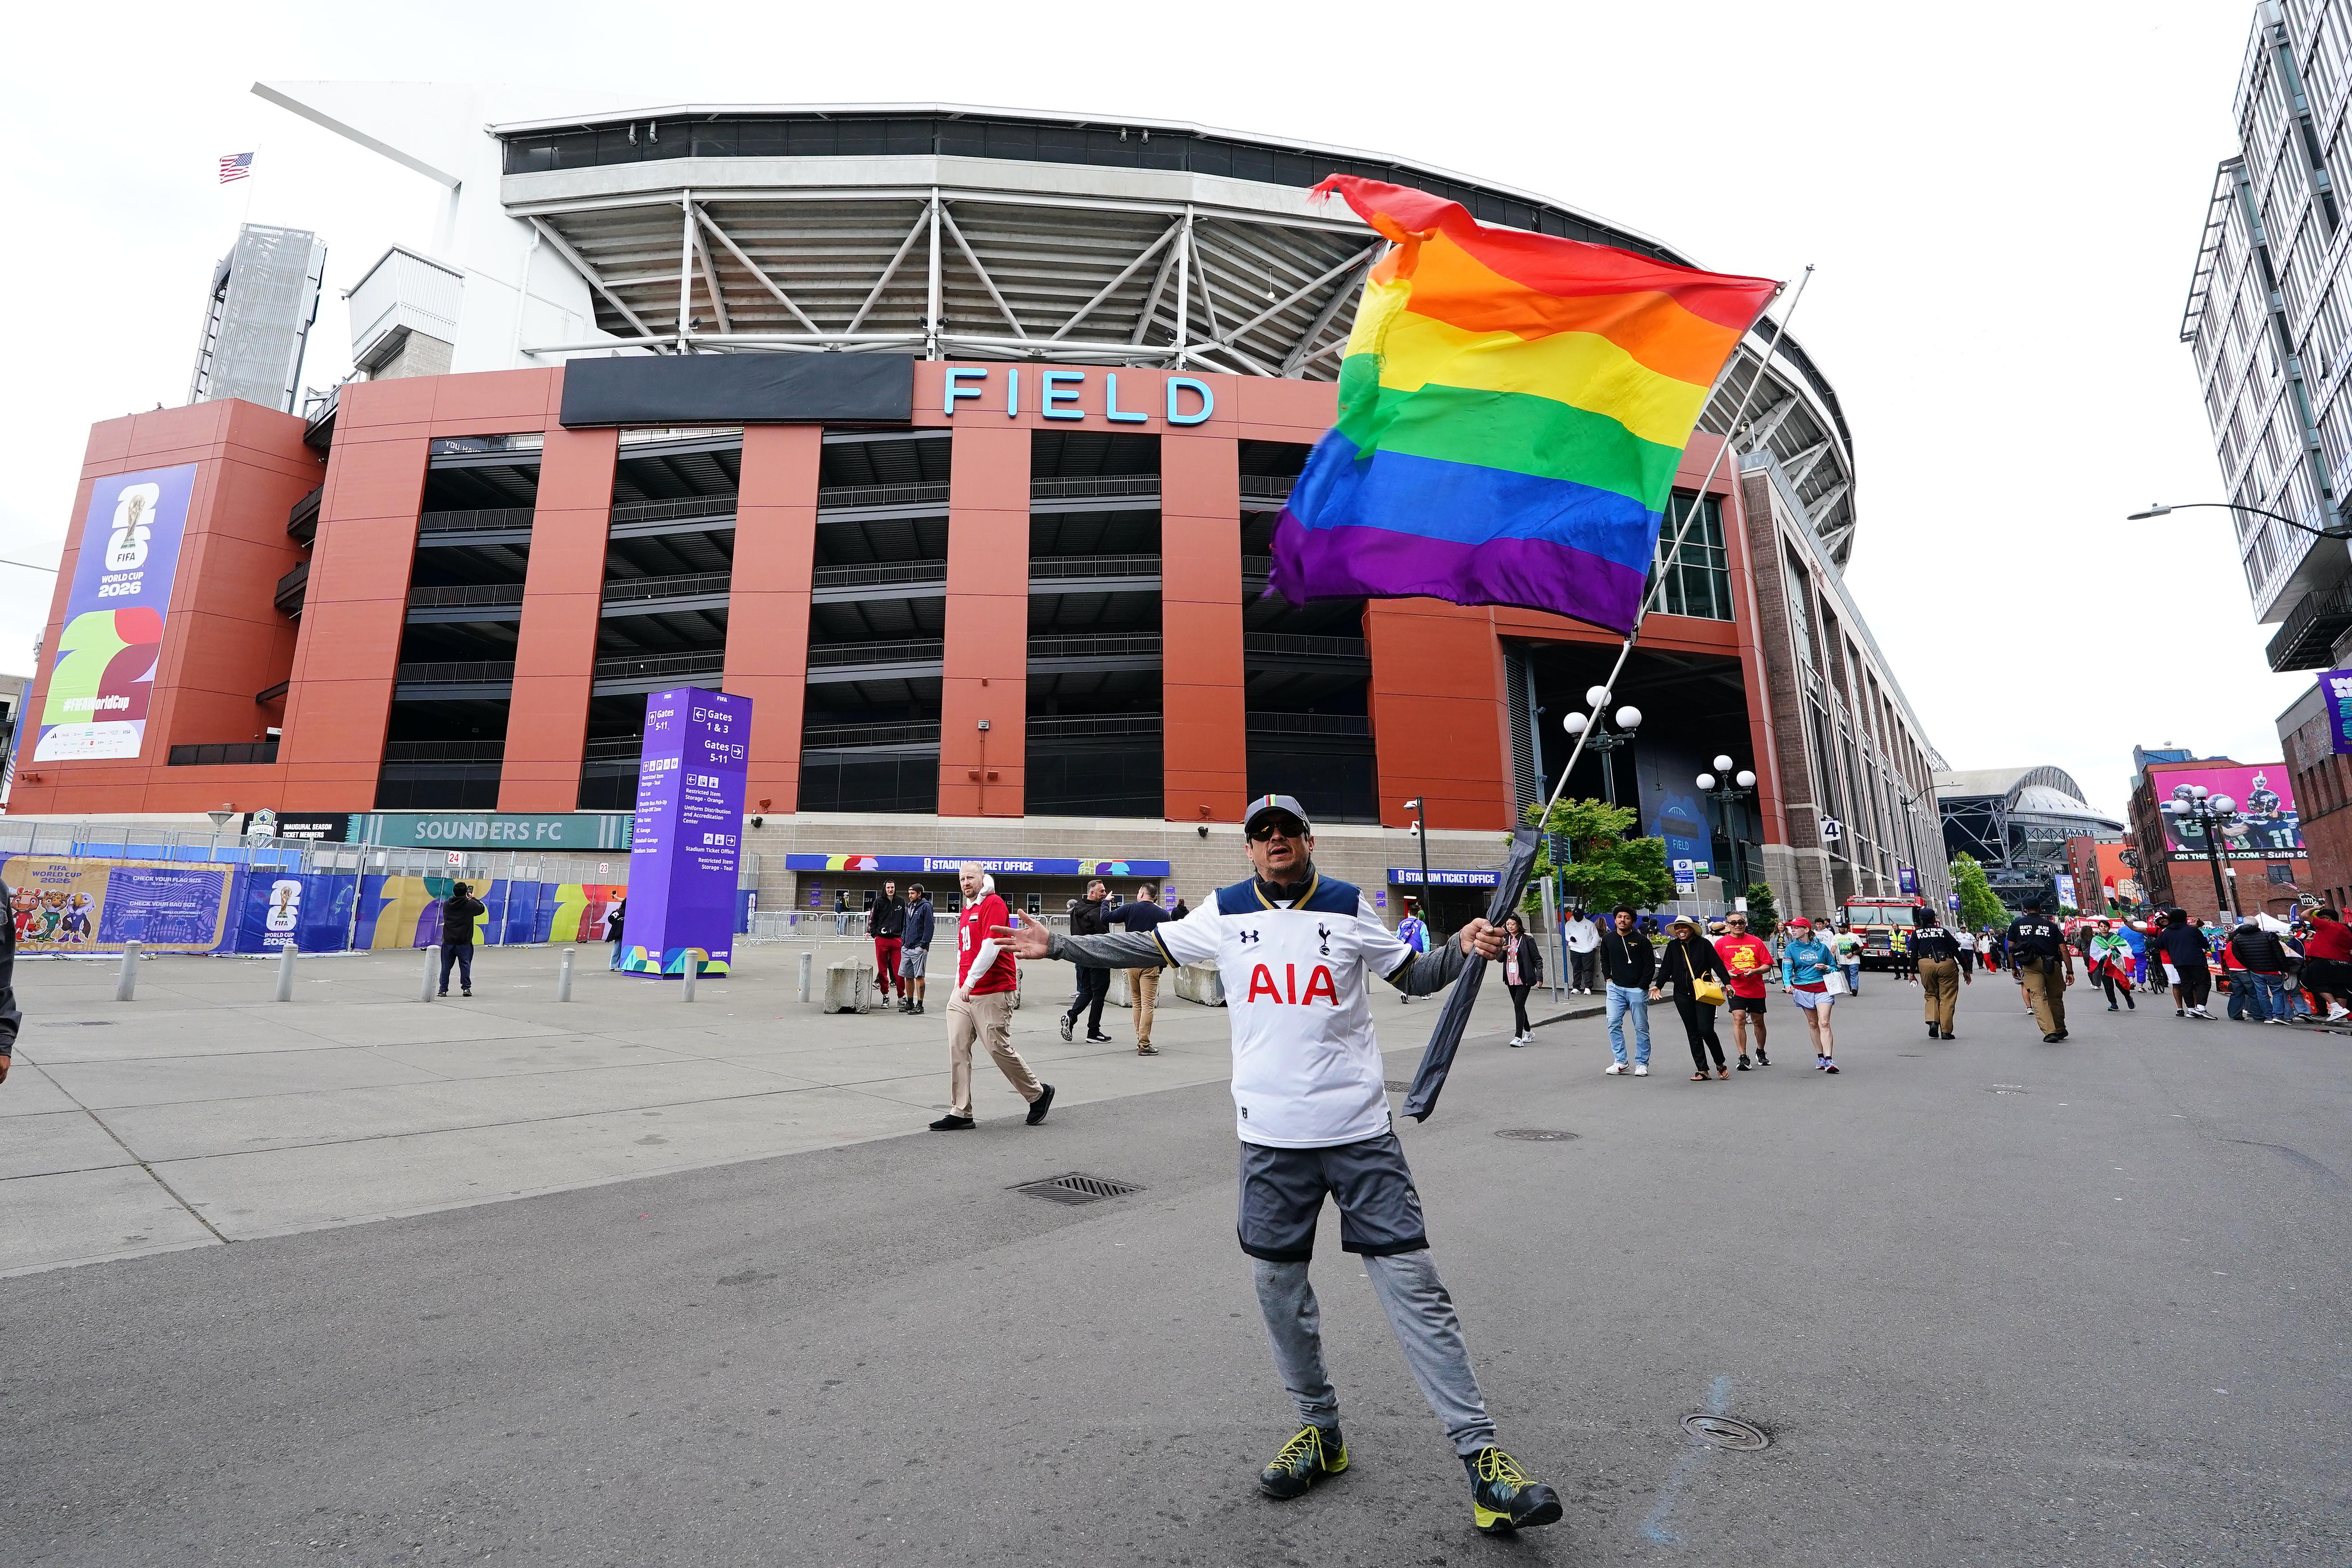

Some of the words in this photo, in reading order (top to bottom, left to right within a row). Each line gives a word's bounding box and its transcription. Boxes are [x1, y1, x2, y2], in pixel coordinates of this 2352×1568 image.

[943, 368, 1215, 425] FIELD
[117, 552, 135, 562] FIFA
[102, 573, 128, 583] WORLD
[128, 571, 144, 580] CUP
[98, 581, 141, 598] 2026
[63, 694, 130, 712] #FIFAWorldCup
[657, 709, 674, 719] Gates
[708, 710, 732, 722] Gates
[655, 721, 668, 731] 5-11
[707, 722, 711, 730] 1
[714, 723, 721, 733] &
[723, 725, 729, 733] 3
[704, 740, 729, 751] Gates
[710, 753, 728, 764] 5-11
[415, 821, 530, 840] SOUNDERS
[535, 822, 562, 840] FC
[1825, 822, 1839, 837] 4
[2268, 828, 2295, 848] 11
[1673, 839, 1689, 851] FIELD
[449, 853, 459, 862] 24
[1004, 861, 1034, 871] OFFICE
[1441, 873, 1468, 883] TICKET
[1469, 874, 1495, 883] OFFICE
[263, 937, 294, 945] 2026
[1247, 964, 1339, 1006] AIA
